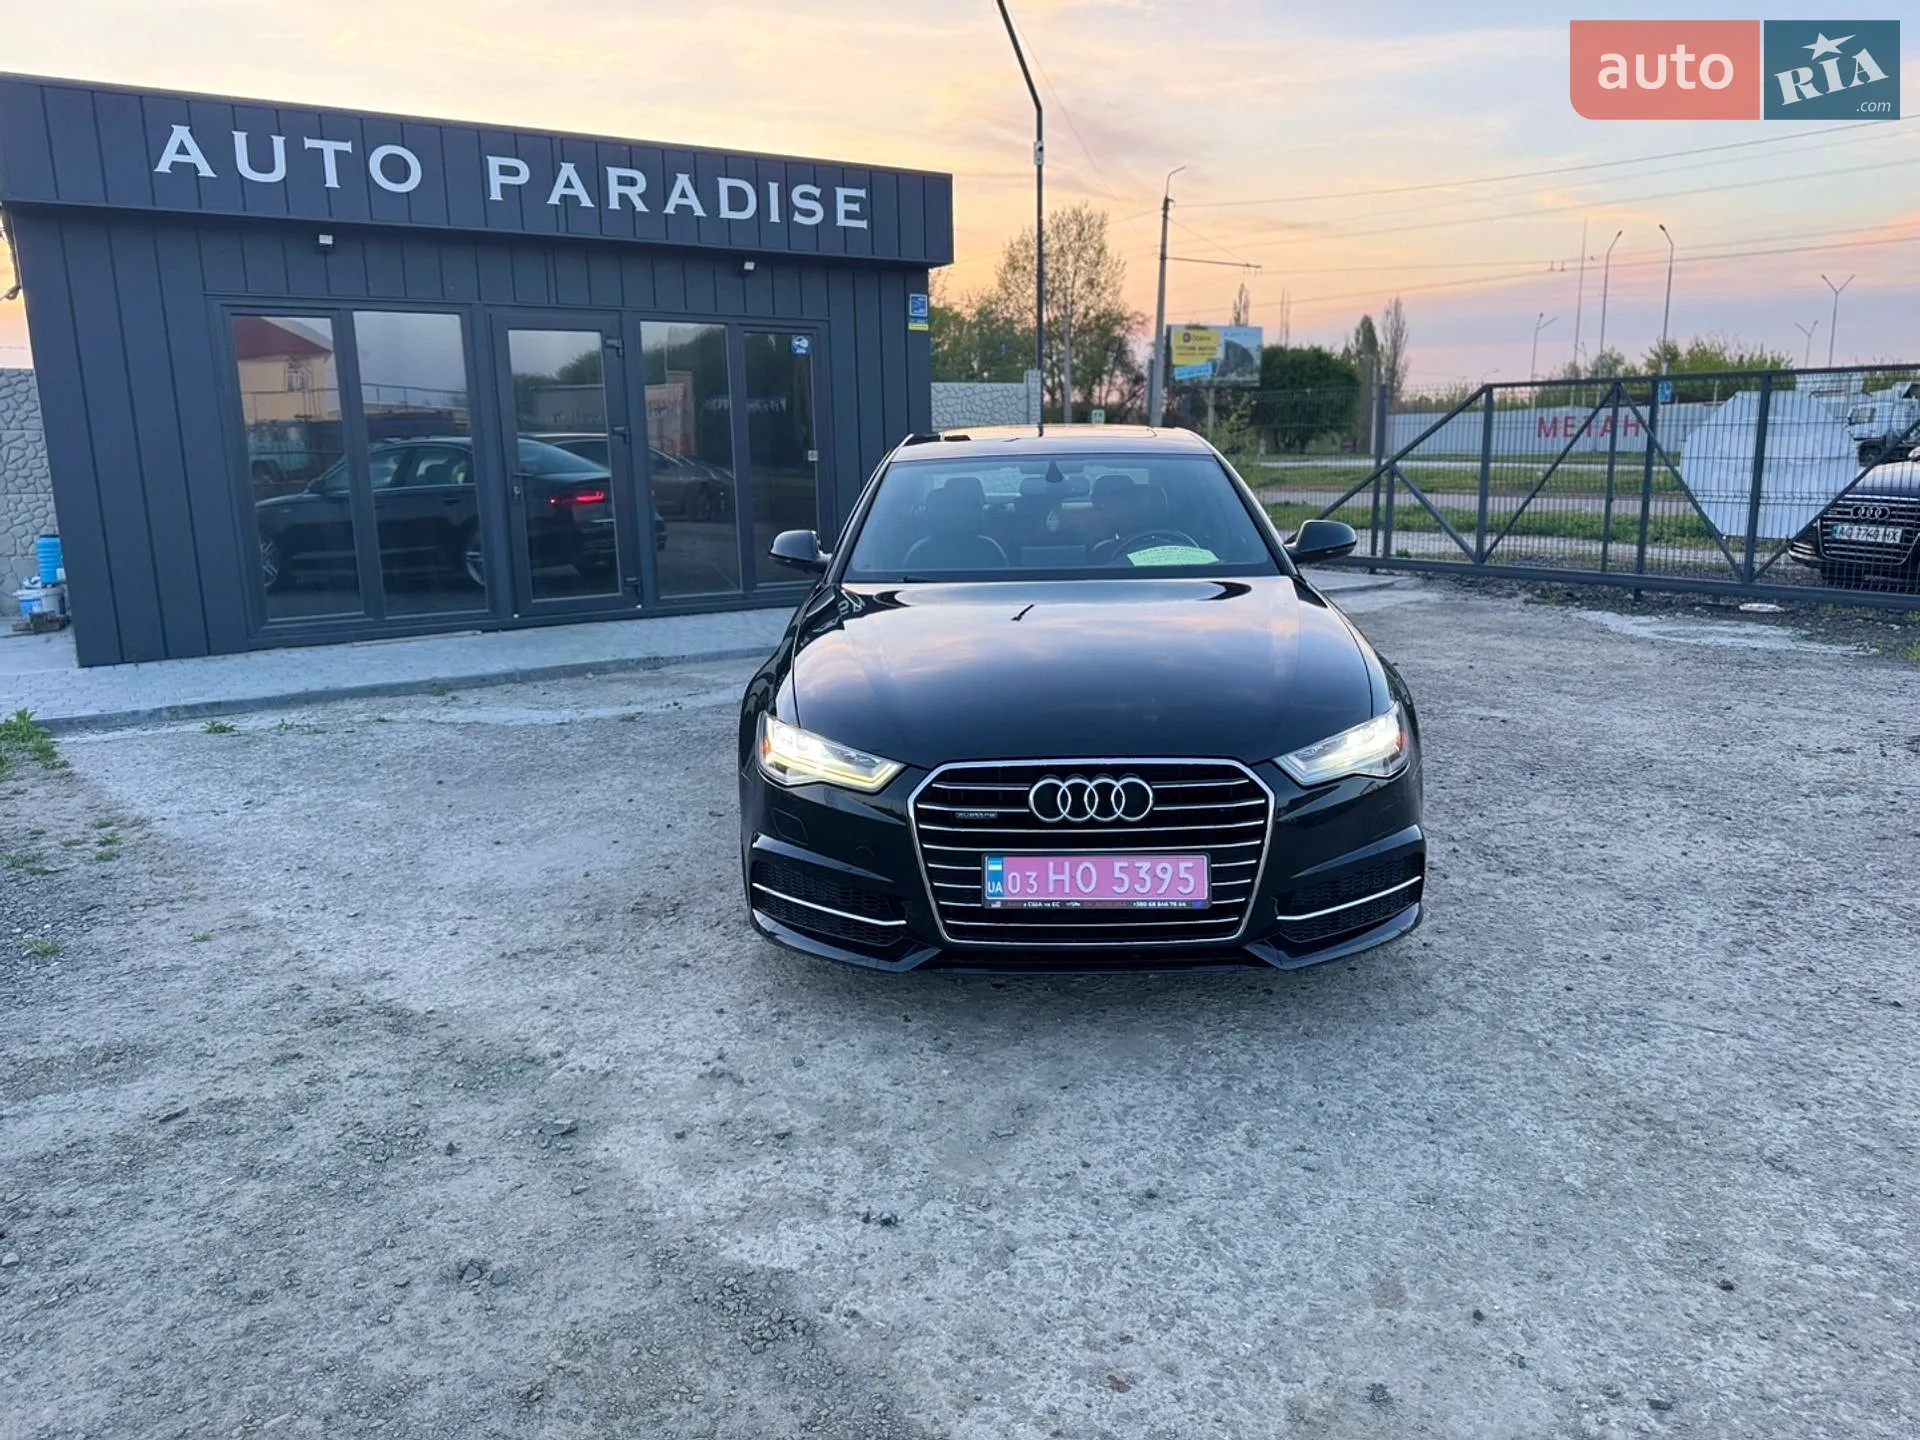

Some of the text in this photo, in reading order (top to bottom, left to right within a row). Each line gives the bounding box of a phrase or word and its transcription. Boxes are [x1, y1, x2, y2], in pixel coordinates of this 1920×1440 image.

[153, 124, 868, 230] AUTO PARADISE
[988, 861, 1196, 895] UA 03 HO 5395
